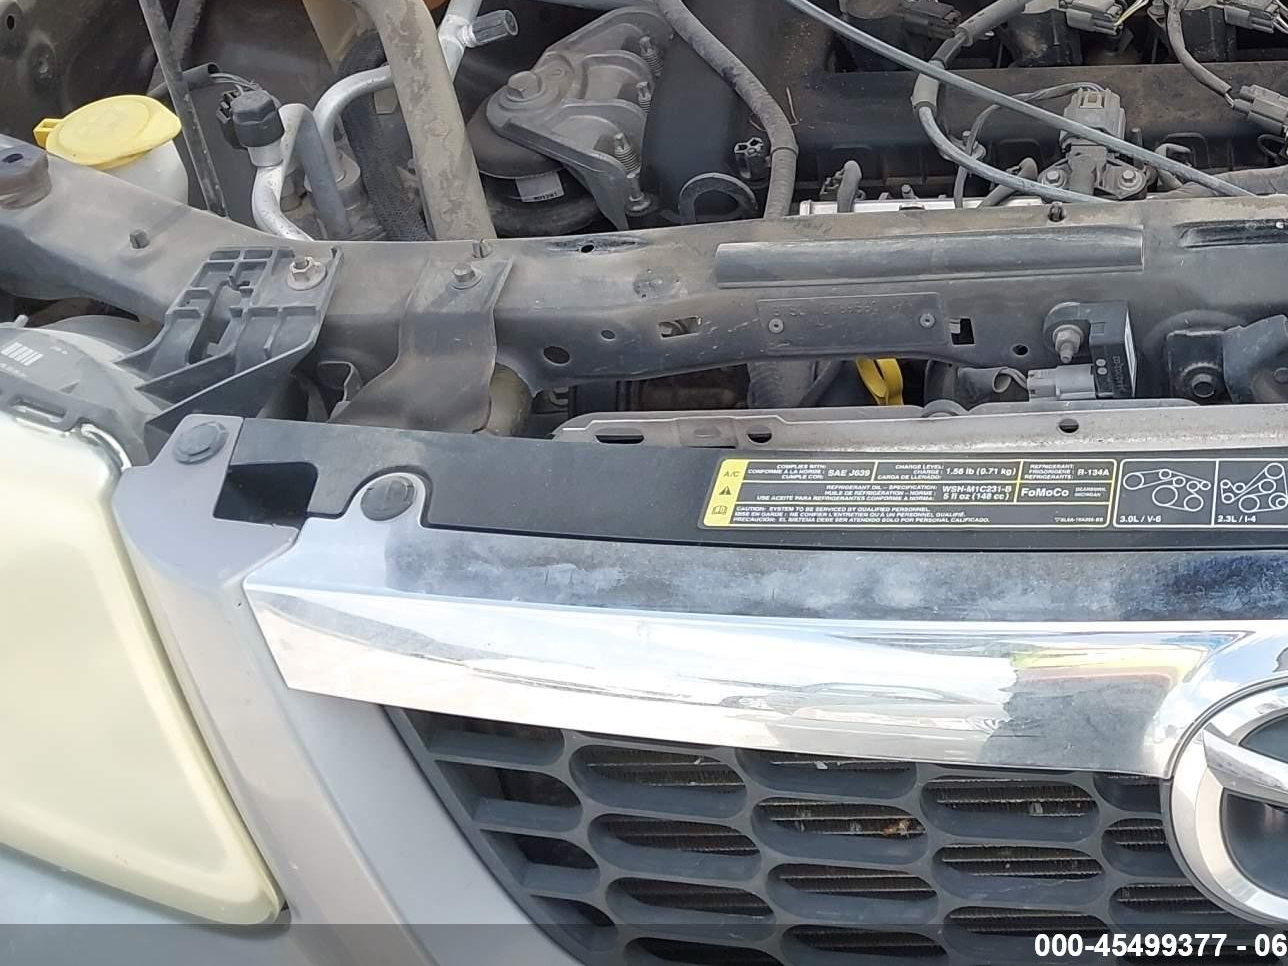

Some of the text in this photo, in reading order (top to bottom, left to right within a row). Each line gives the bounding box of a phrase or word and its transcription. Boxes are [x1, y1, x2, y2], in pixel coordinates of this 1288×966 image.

[976, 468, 999, 476] (0.71
[1000, 468, 1016, 476] kg)
[1020, 488, 1070, 497] FoMoCo
[993, 493, 1010, 502] cc)
